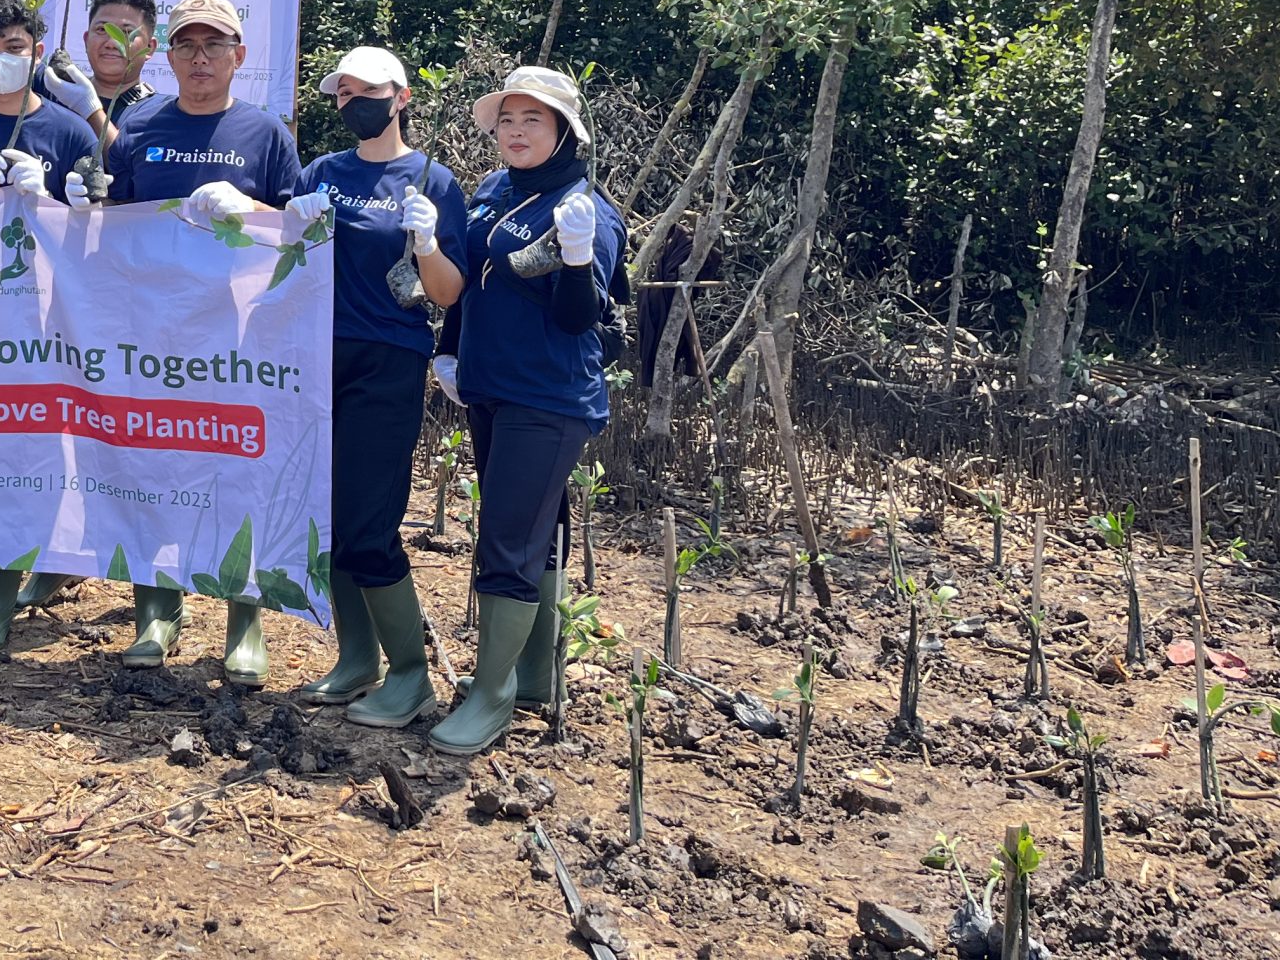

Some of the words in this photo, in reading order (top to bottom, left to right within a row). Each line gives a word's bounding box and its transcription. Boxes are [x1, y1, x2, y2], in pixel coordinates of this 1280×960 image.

[164, 148, 245, 167] Praisindo
[328, 185, 398, 211] Praisindo
[117, 343, 300, 393] Together:
[56, 397, 116, 434] Tree
[126, 411, 260, 454] Planting
[59, 474, 79, 491] 16
[85, 477, 164, 505] Desember
[170, 490, 212, 509] 2023
